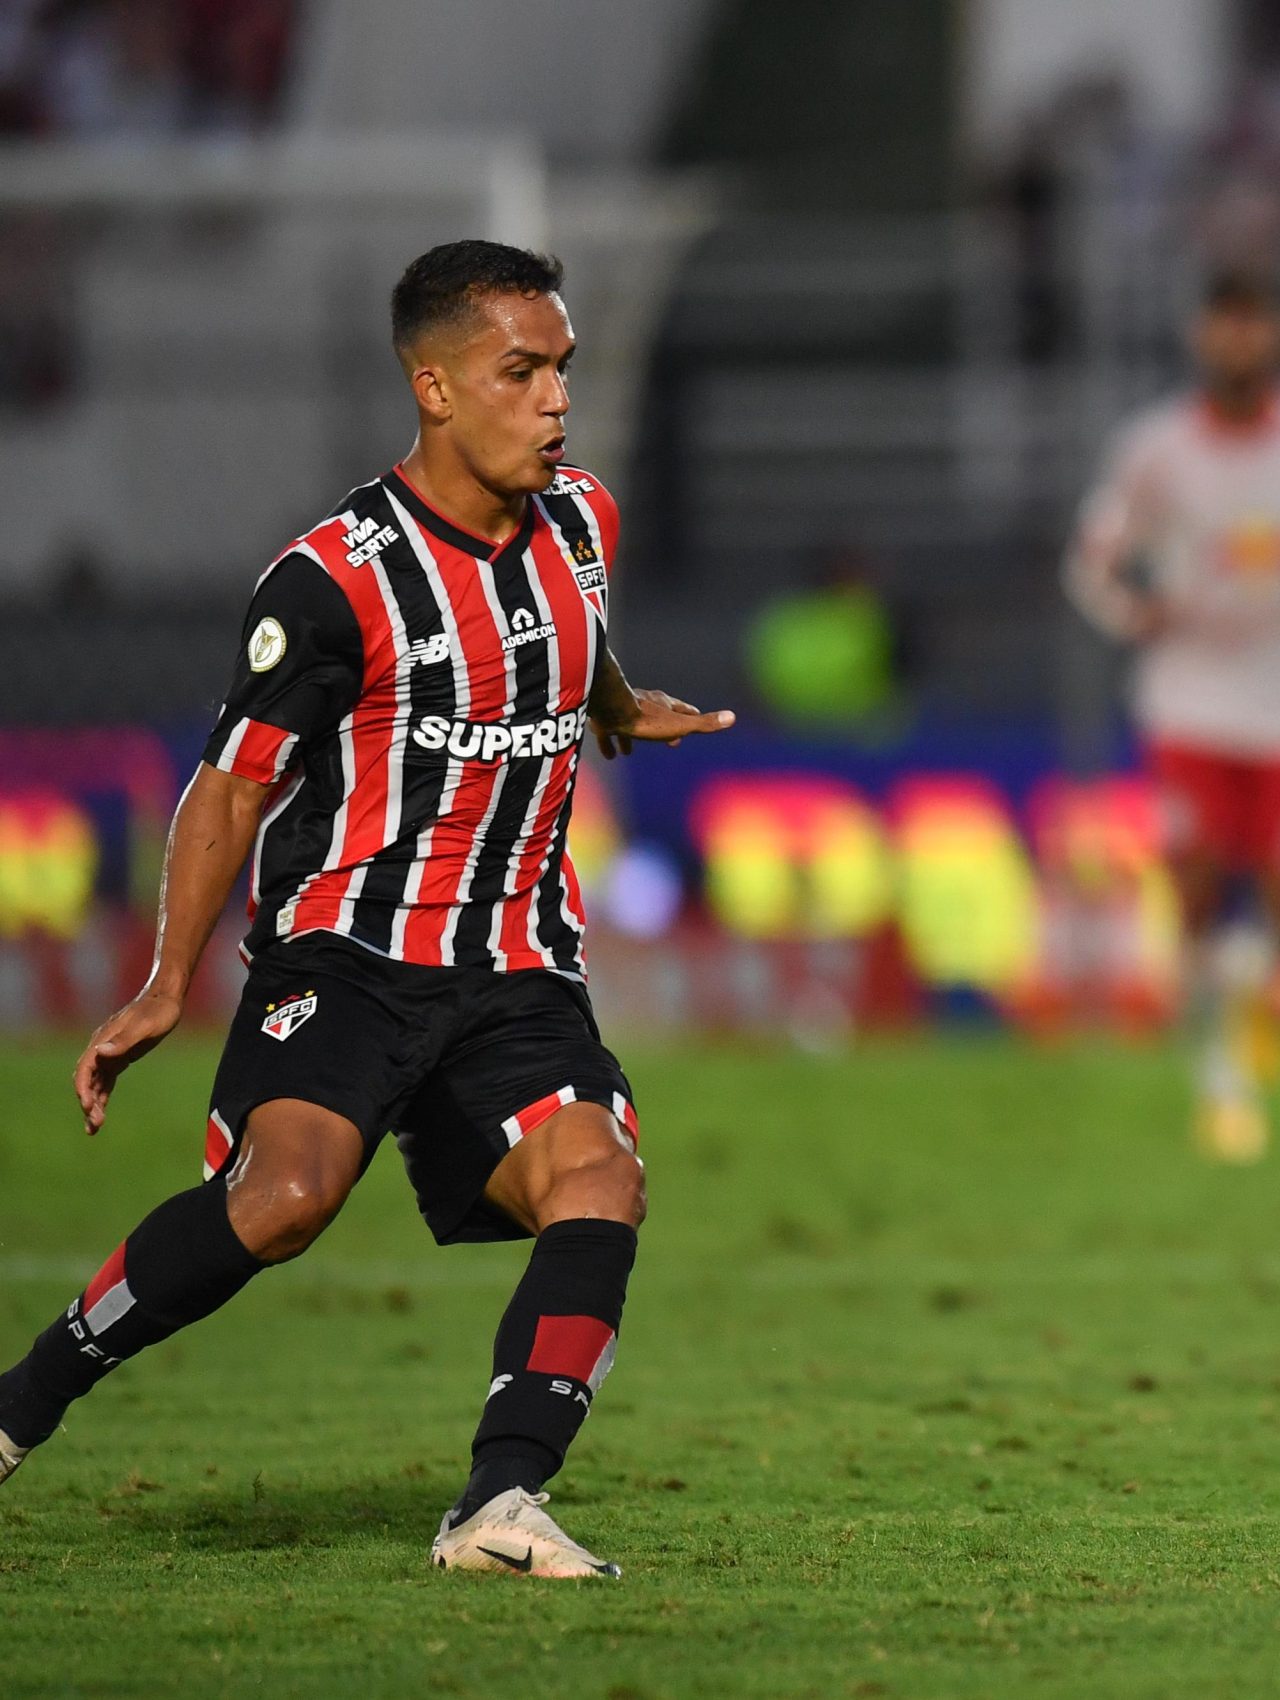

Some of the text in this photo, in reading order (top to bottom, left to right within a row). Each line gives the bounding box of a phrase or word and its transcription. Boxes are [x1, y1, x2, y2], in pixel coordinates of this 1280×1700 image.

[341, 516, 380, 549] VIVA
[345, 524, 400, 568] SORTE
[501, 623, 556, 651] ADEMICON
